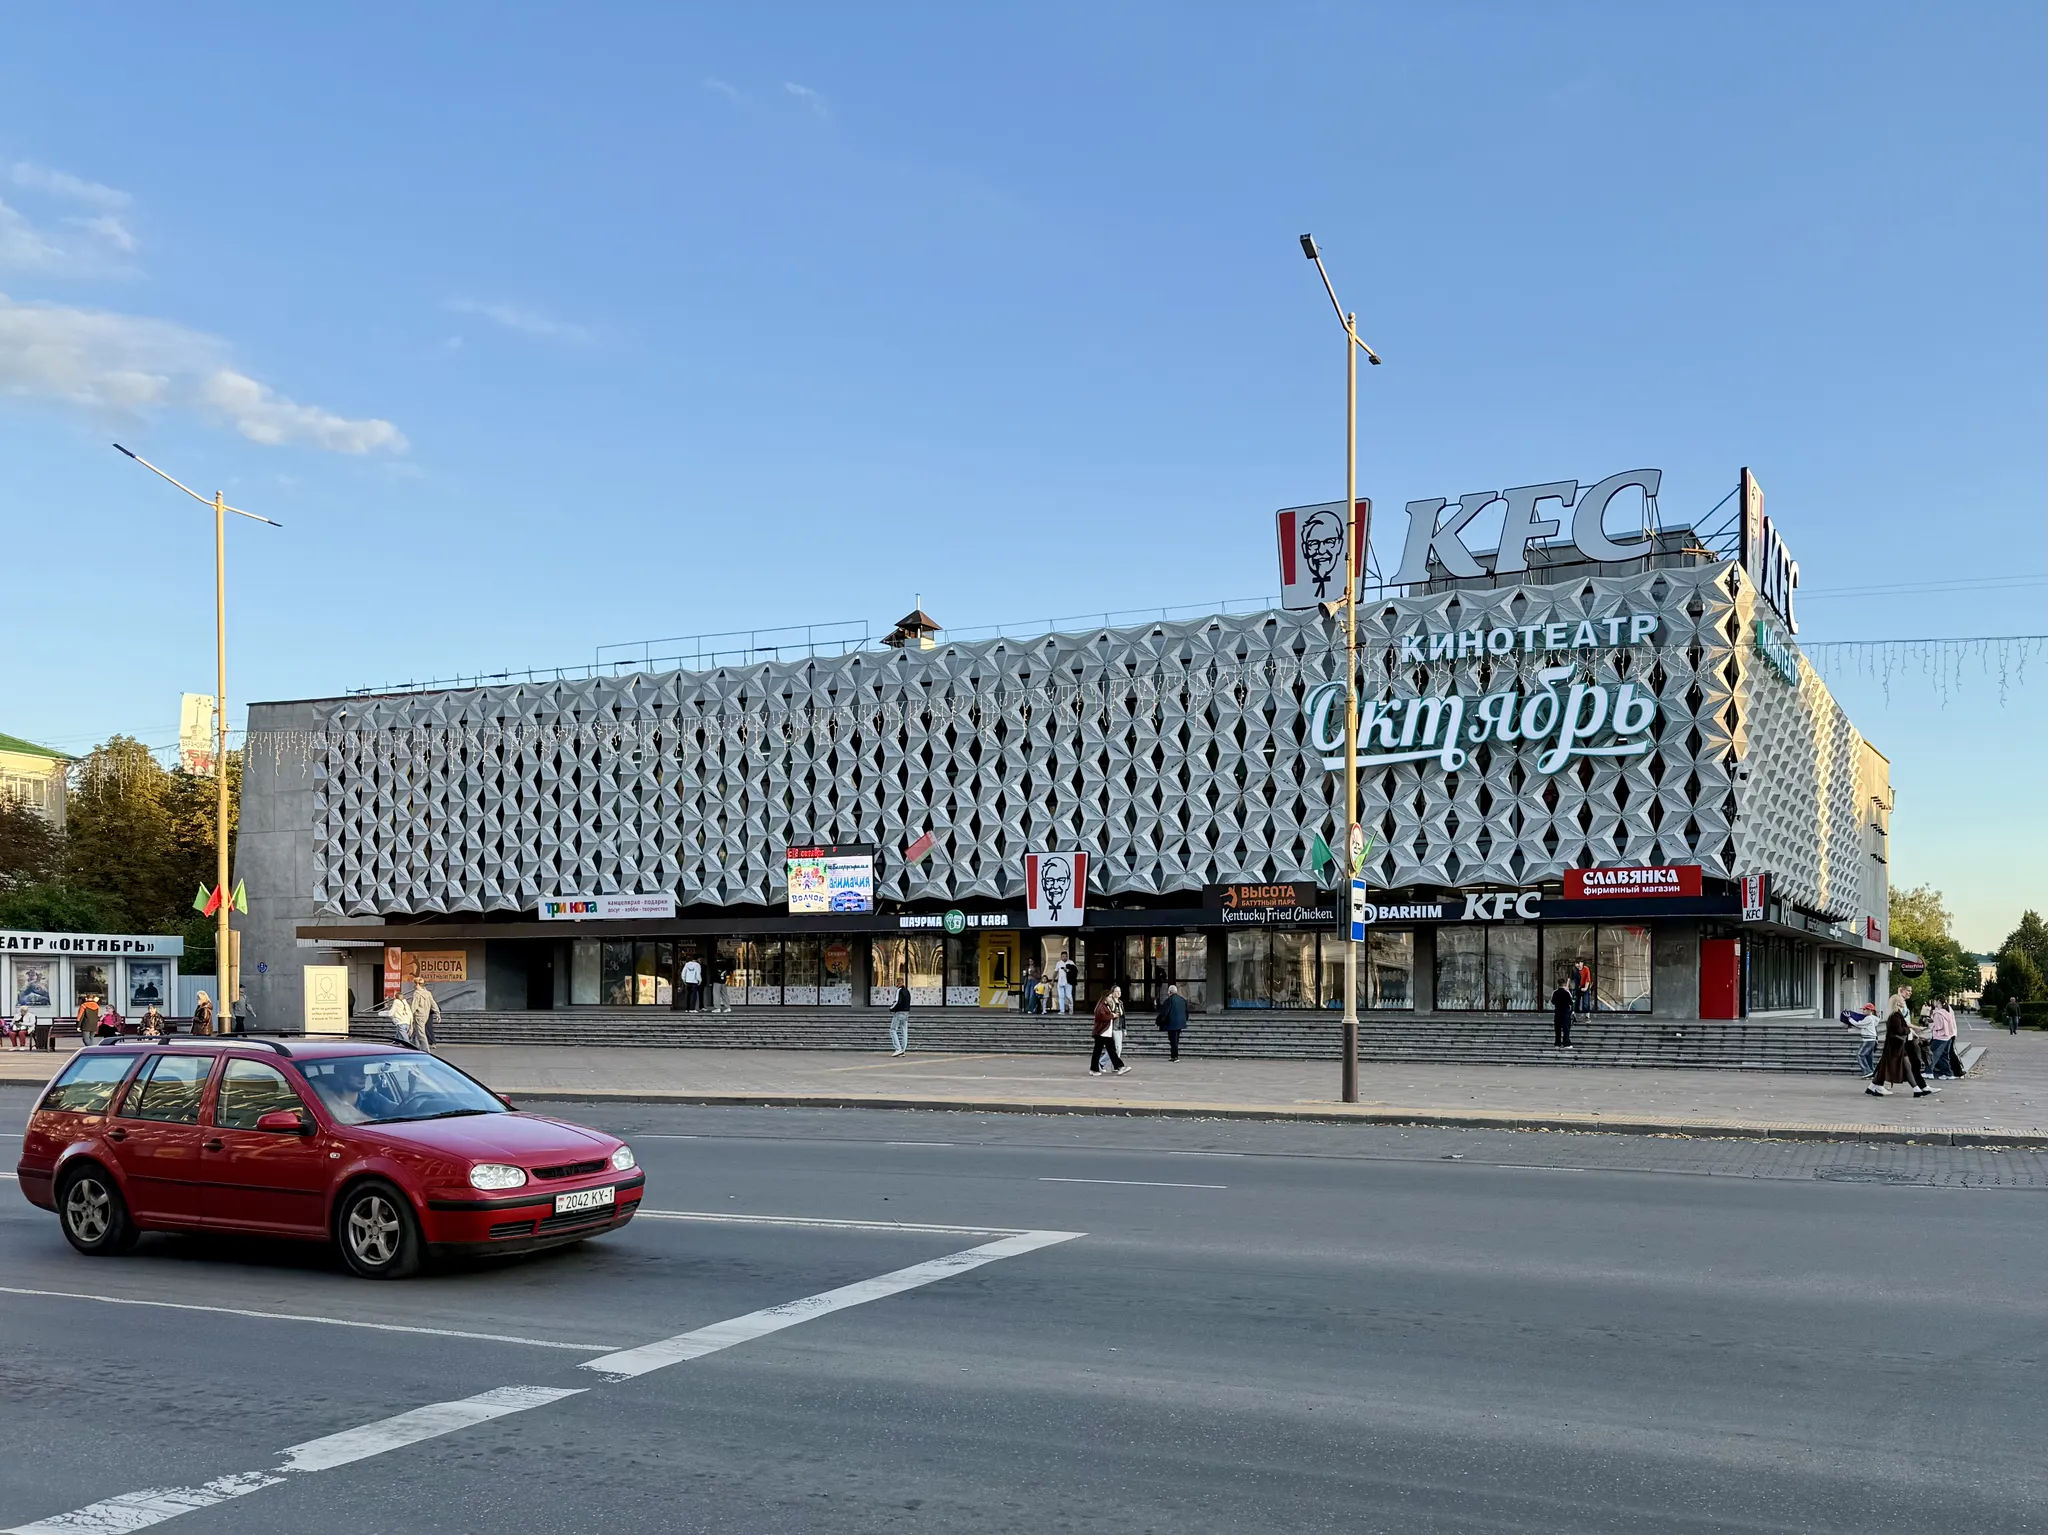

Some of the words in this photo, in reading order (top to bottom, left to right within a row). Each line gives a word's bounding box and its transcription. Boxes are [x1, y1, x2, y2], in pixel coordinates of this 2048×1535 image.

[1390, 469, 1662, 586] KFC
[1761, 514, 1799, 635] KFC
[1401, 615, 1658, 662] КИНОТЕАТР
[1305, 662, 1657, 774] Октябрь
[1582, 869, 1679, 885] СЛАВЯНКА
[1241, 885, 1296, 898] ВЫСОТА
[1583, 885, 1640, 896] фирменный
[1642, 885, 1681, 893] магазин
[545, 901, 567, 917] три
[569, 901, 598, 914] кота
[1379, 905, 1442, 919] BARHIM
[1461, 892, 1542, 920] KFC
[899, 916, 943, 928] ШАУРМА
[981, 914, 1008, 926] КАВА
[1222, 908, 1266, 924] Kentucky
[1266, 907, 1292, 922] Fried
[1293, 906, 1334, 921] Chicken
[1745, 909, 1761, 920] KFC
[49, 938, 154, 952] «ОКТЯБРЬ»
[420, 961, 463, 972] ВЫСОТА
[566, 1193, 589, 1209] 2042
[592, 1188, 613, 1205] KX-1
